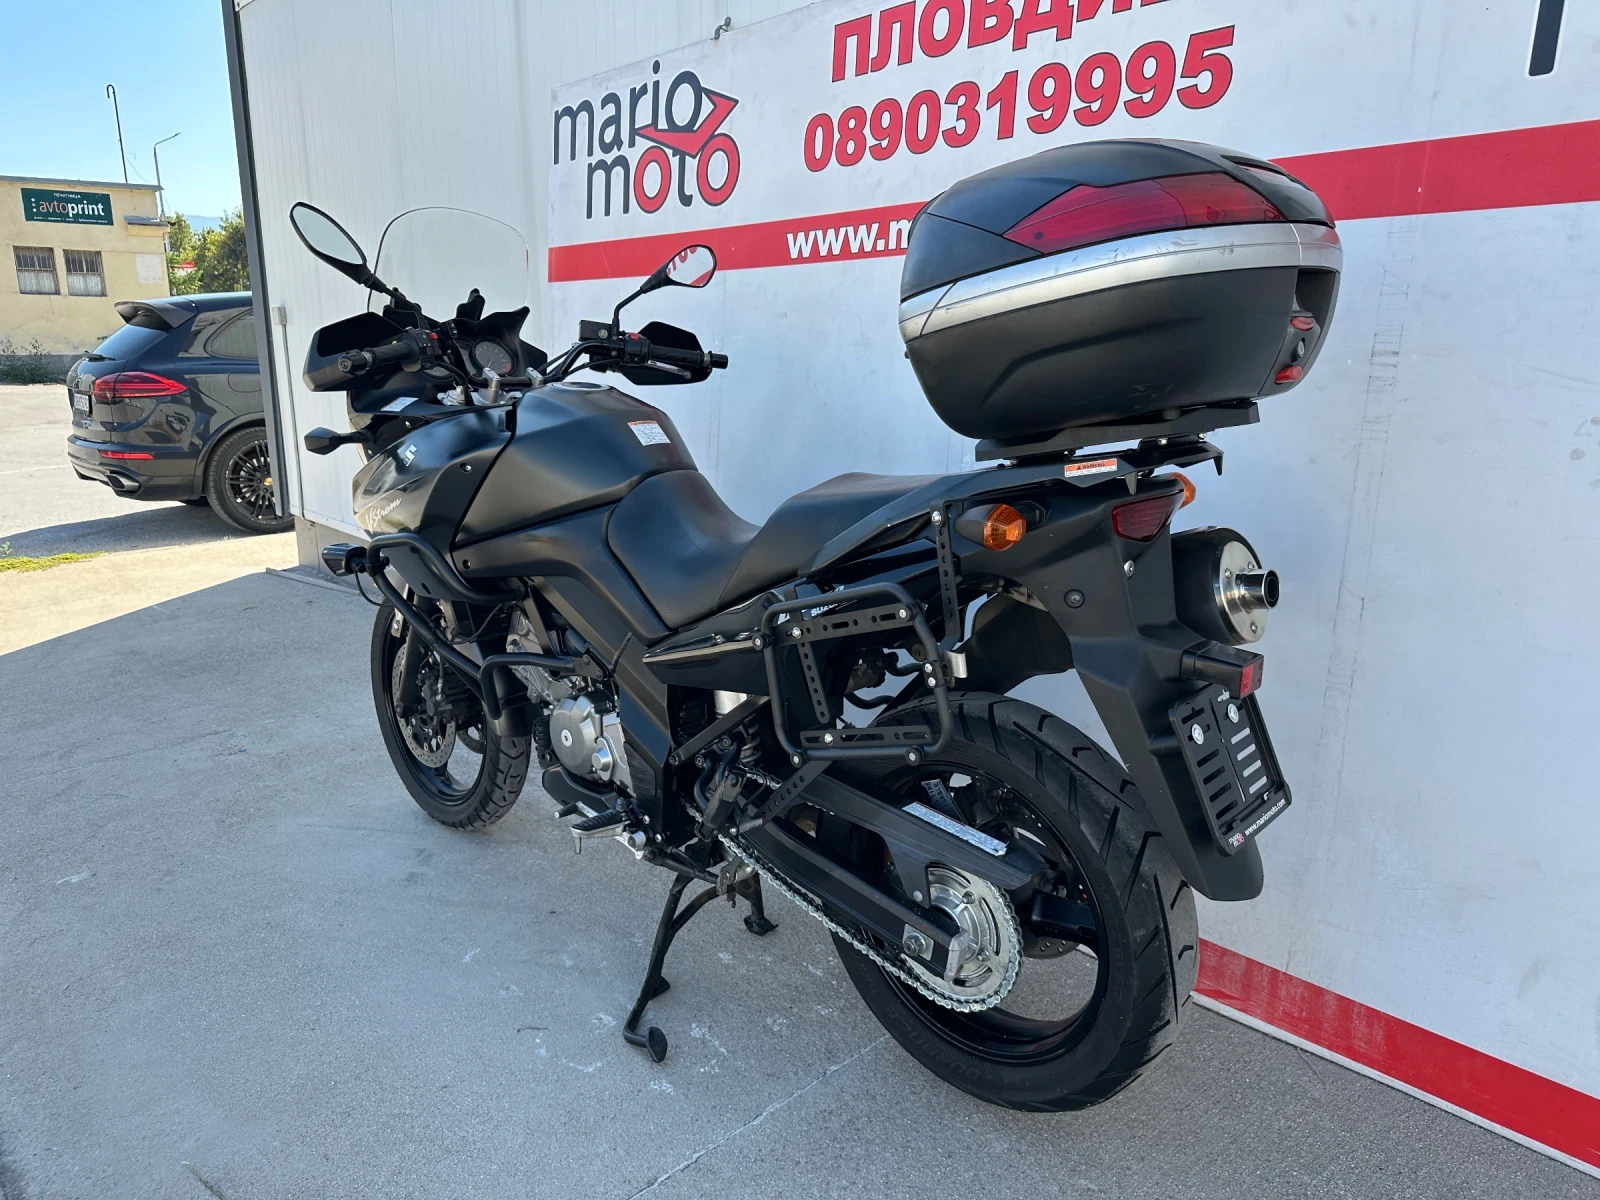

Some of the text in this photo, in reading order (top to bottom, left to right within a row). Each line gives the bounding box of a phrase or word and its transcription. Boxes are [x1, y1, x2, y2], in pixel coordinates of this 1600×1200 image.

[831, 0, 1172, 82] ПЛОВД
[553, 59, 702, 165] mario
[803, 25, 1235, 172] 0890319995
[39, 200, 105, 217] avtoprint
[586, 133, 740, 219] moto
